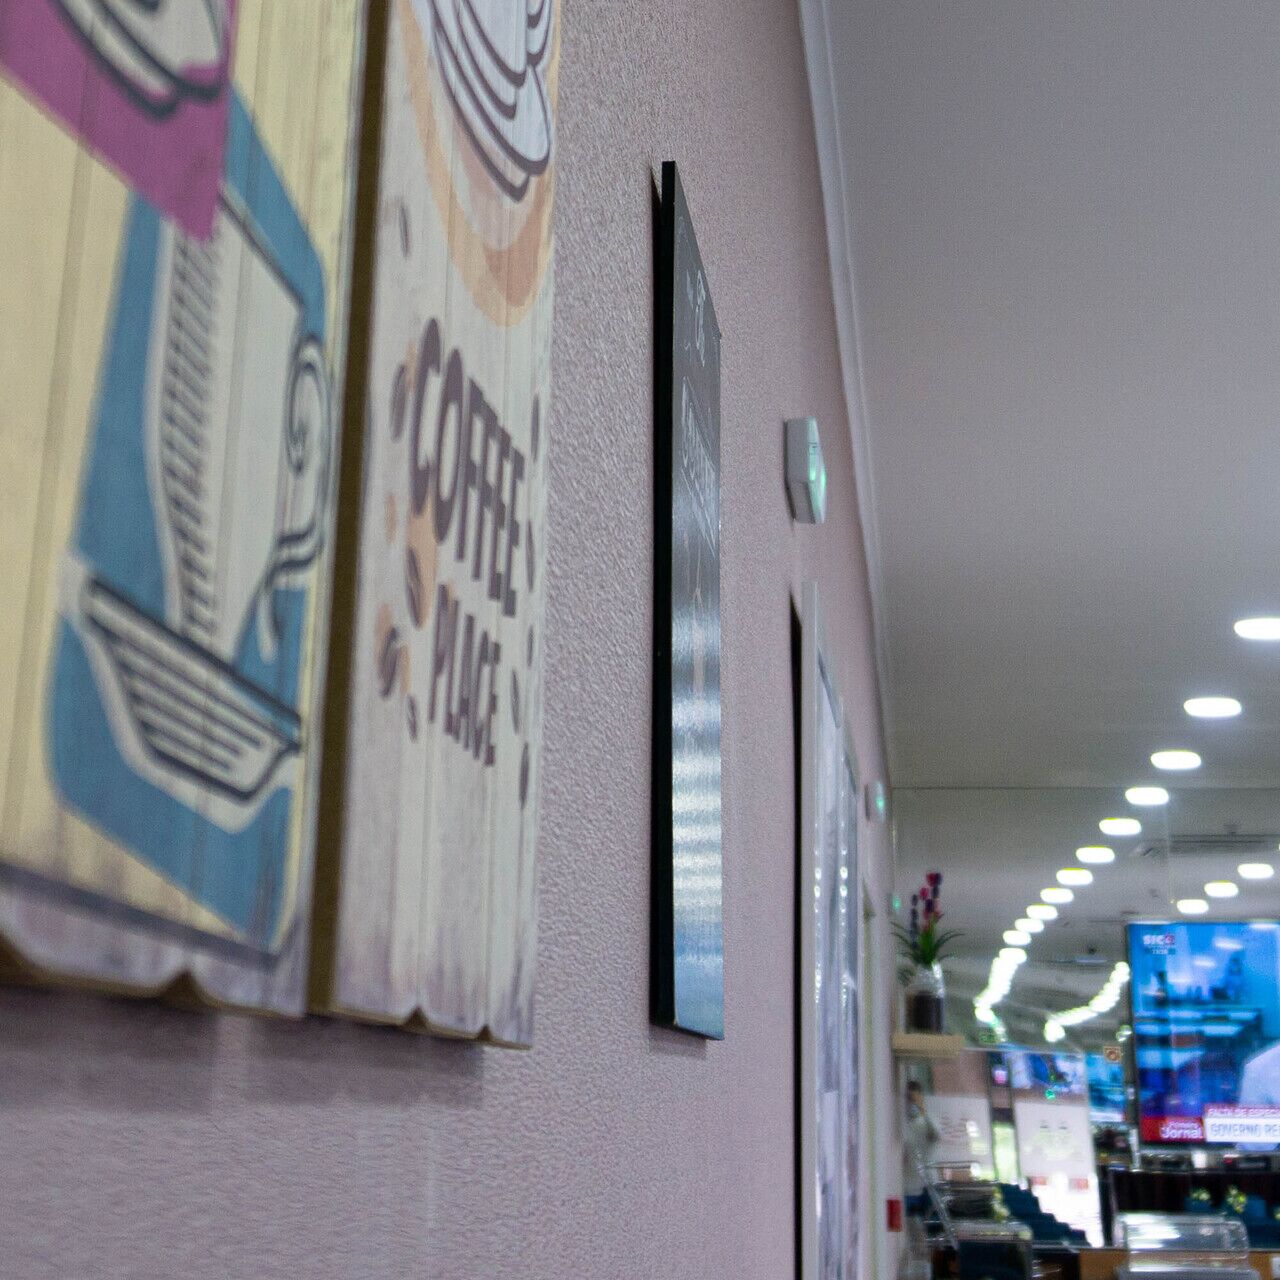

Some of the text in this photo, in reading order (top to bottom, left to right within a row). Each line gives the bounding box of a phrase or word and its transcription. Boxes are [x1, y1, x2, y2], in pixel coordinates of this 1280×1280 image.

[410, 317, 525, 618] COFFEE
[428, 582, 500, 768] PLACE
[1210, 1123, 1261, 1138] GOVERNO
